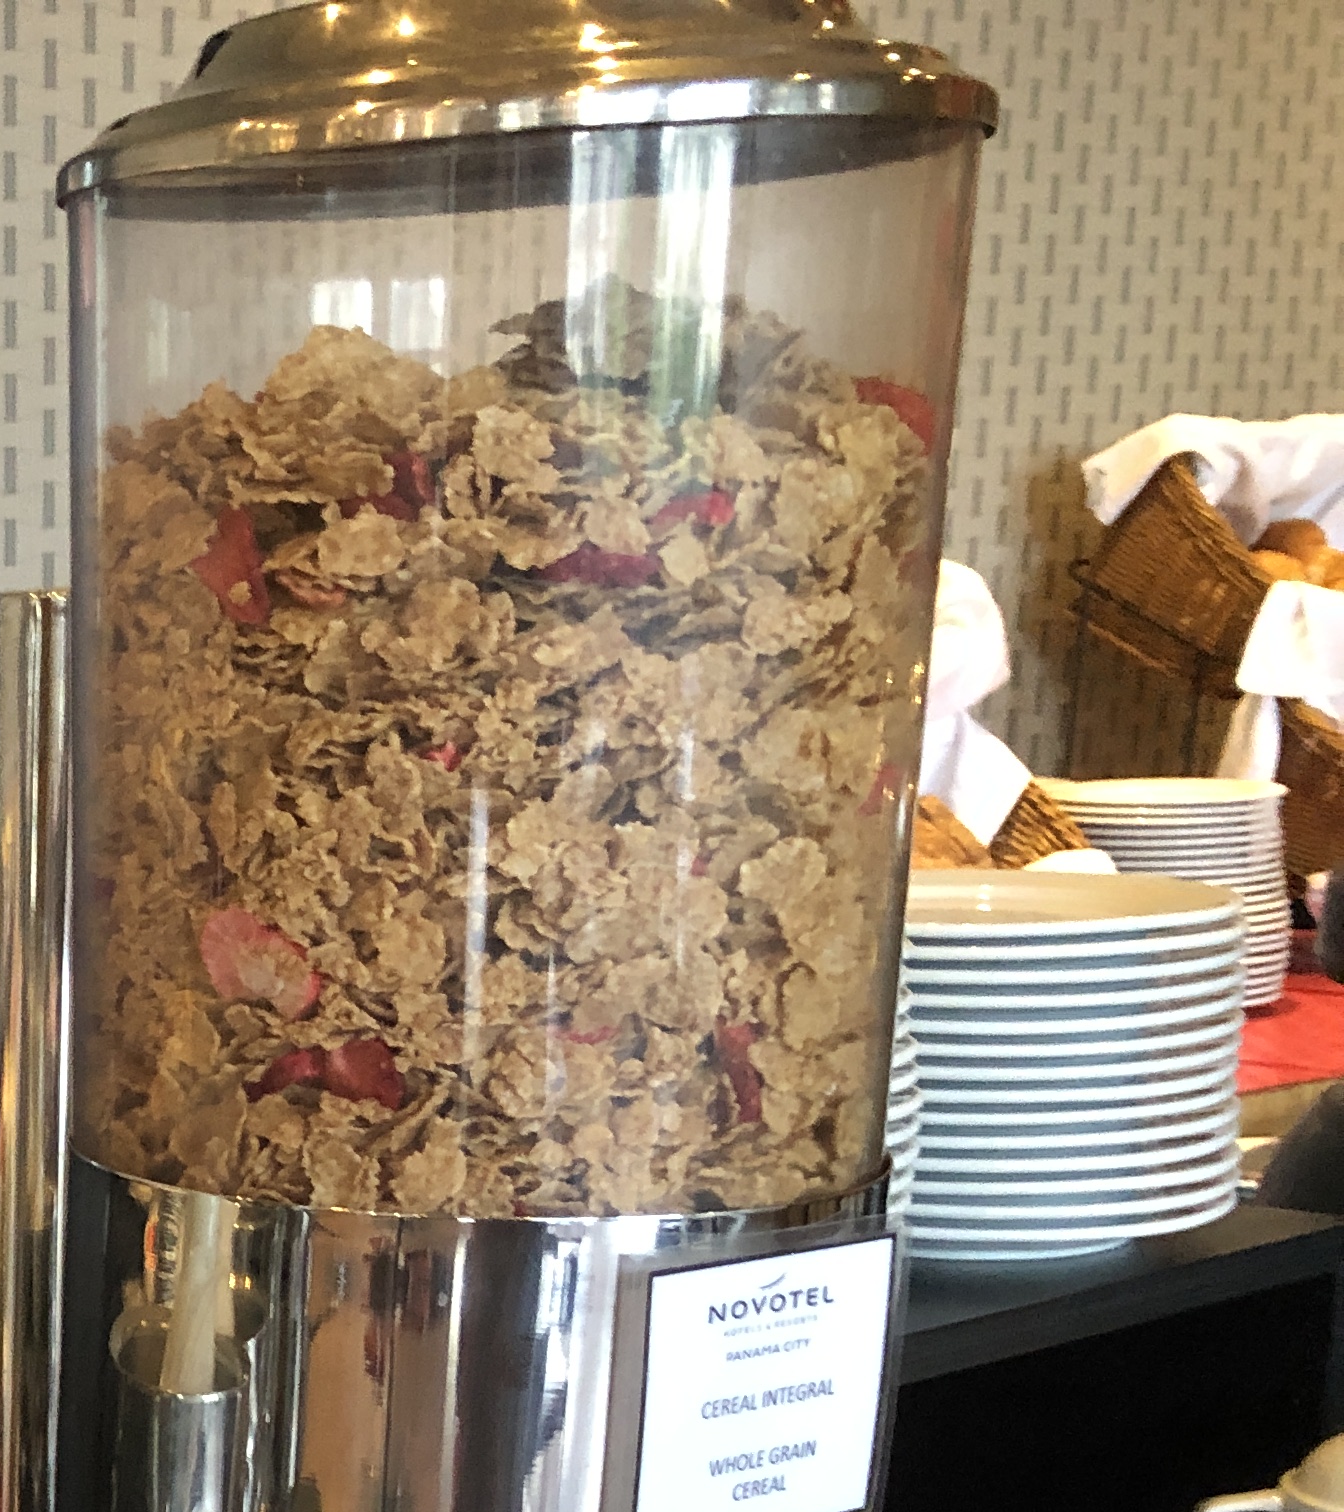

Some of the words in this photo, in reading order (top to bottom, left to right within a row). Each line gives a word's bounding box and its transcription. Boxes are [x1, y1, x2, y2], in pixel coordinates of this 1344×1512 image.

[708, 1286, 834, 1324] NOVOTEL
[726, 1344, 780, 1362] PANAMA
[784, 1338, 810, 1352] CITY
[701, 1394, 756, 1419] CEREAL
[762, 1379, 834, 1408] INTEGRAL
[709, 1450, 764, 1477] WHOLE
[768, 1440, 817, 1464] GRAIN
[732, 1475, 785, 1501] CEREAL
